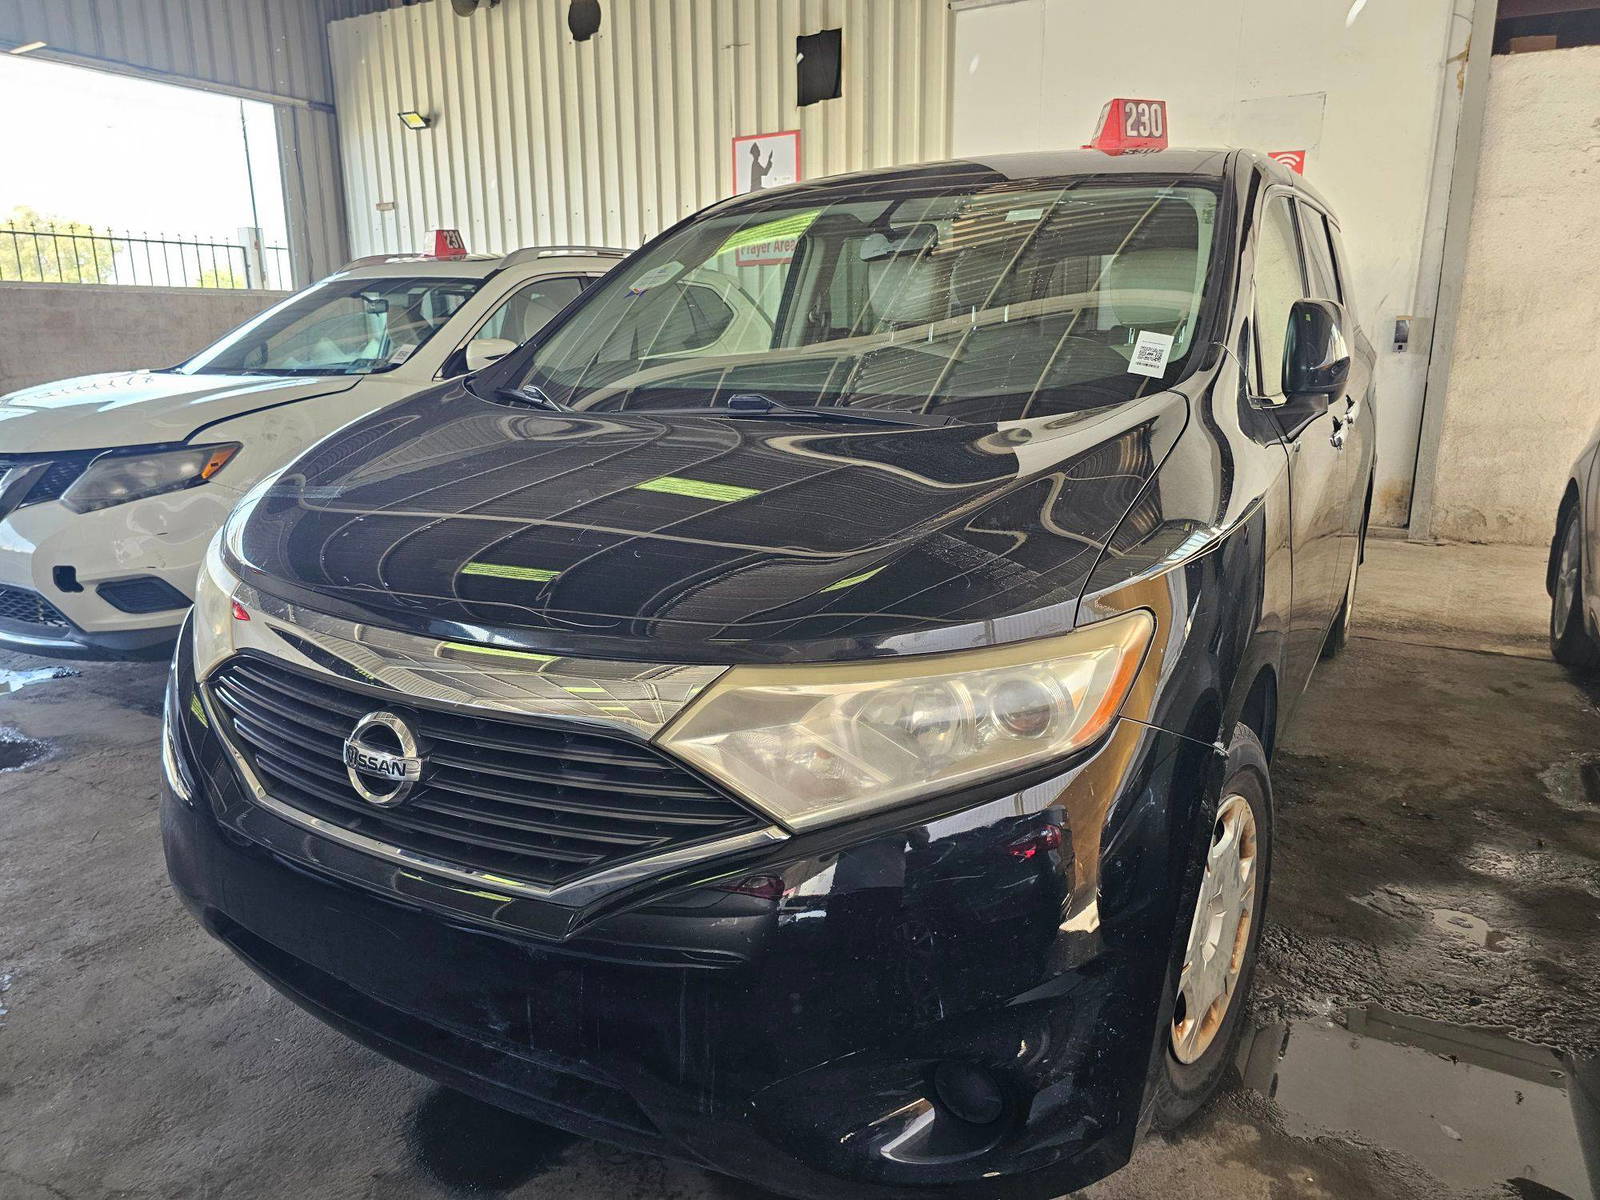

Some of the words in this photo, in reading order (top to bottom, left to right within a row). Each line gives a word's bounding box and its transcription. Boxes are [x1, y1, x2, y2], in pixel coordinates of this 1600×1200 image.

[1125, 103, 1163, 137] 230
[774, 239, 797, 252] Area
[346, 745, 407, 776] NISSAN
